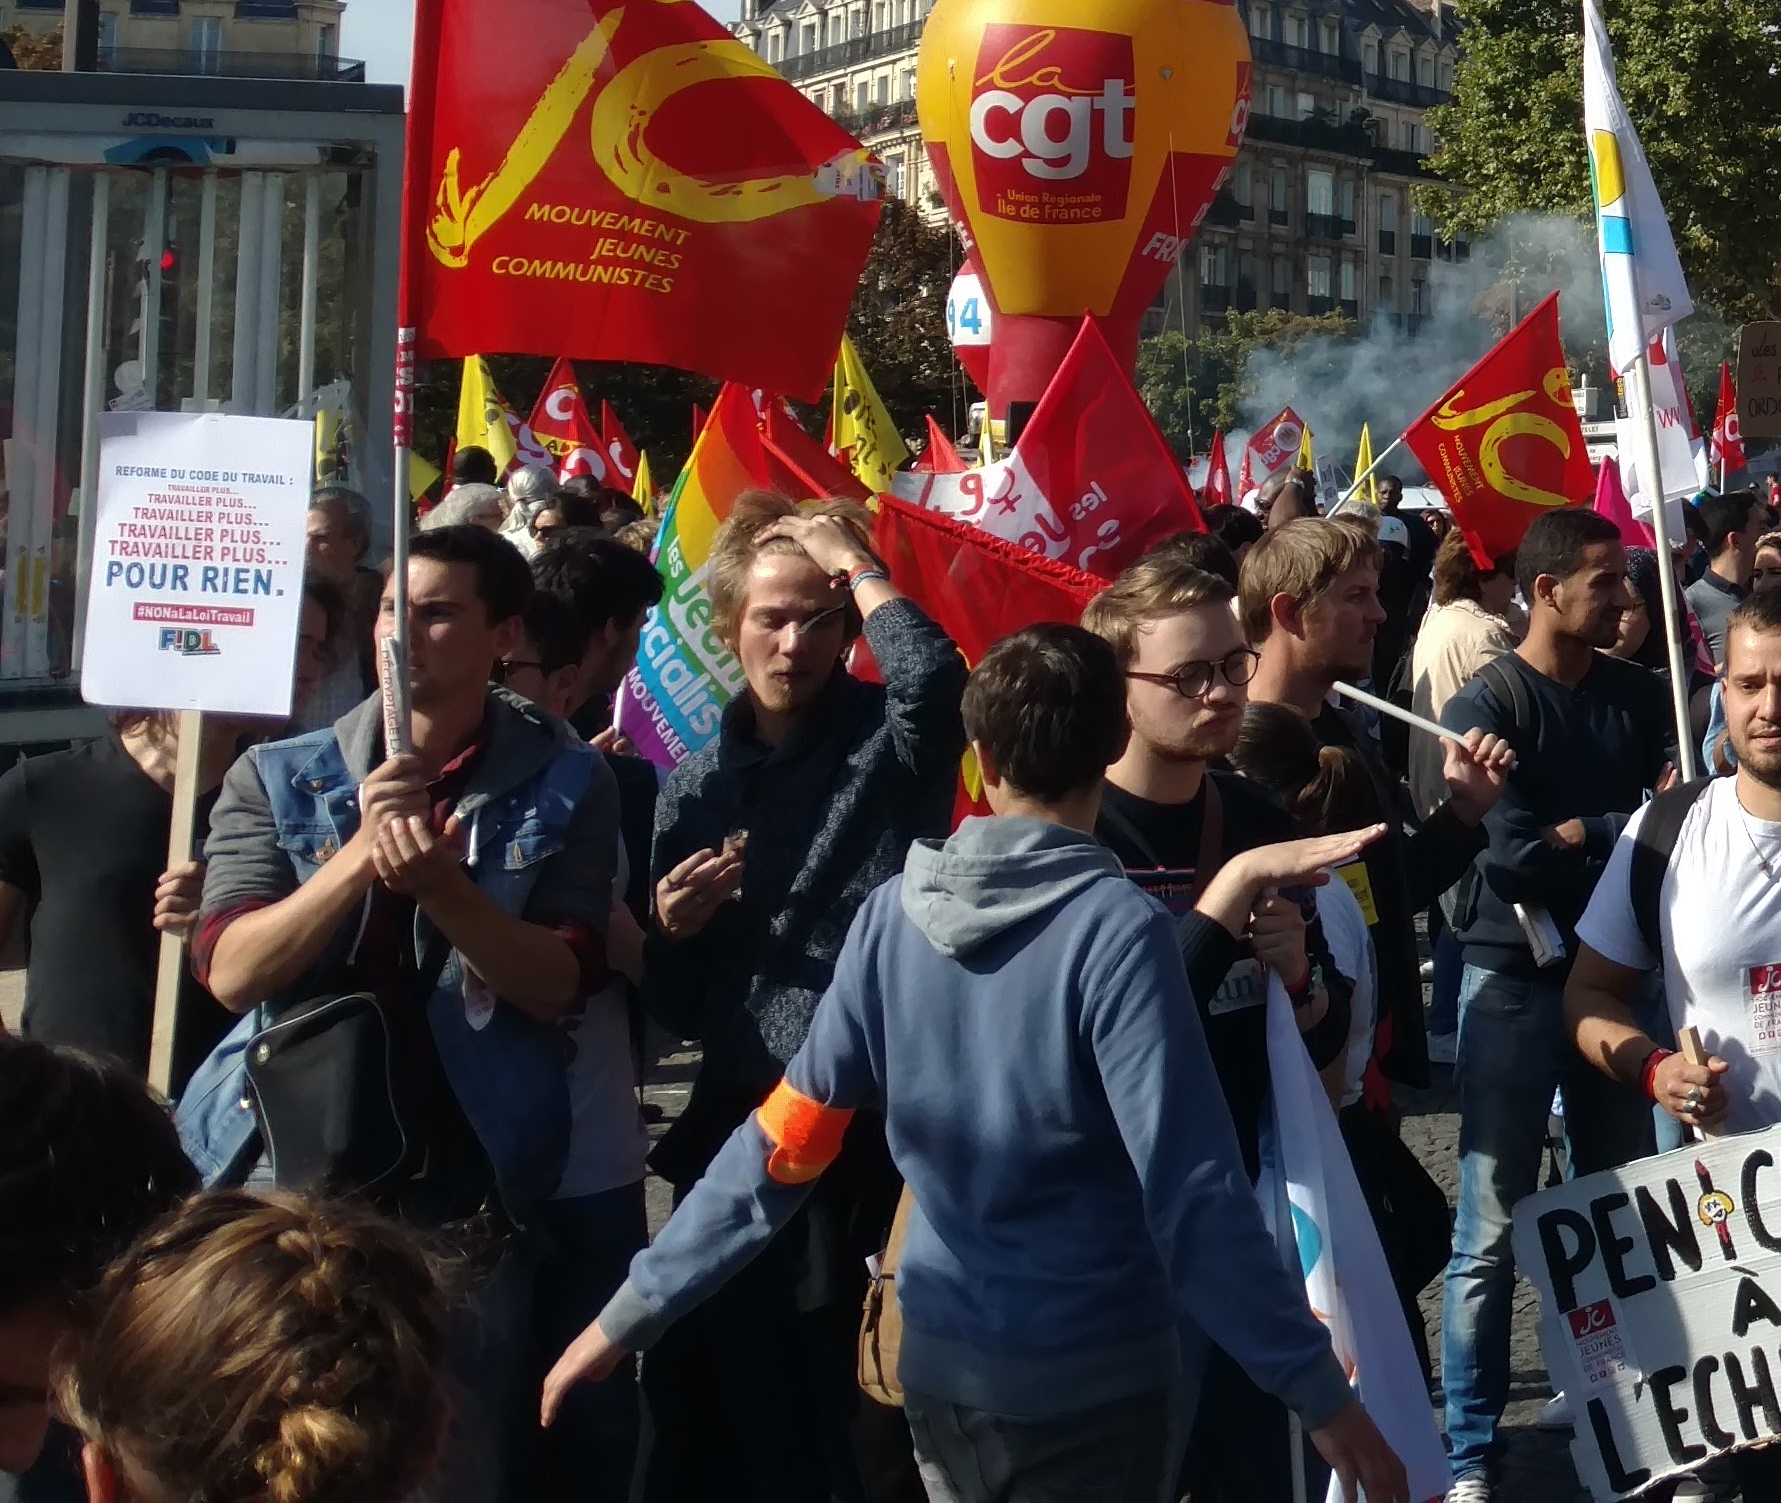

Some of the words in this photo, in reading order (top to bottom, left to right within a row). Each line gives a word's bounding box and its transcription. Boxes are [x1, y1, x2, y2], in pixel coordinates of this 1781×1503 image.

[970, 78, 1136, 180] cgt
[1019, 204, 1040, 219] de
[1044, 203, 1103, 220] France
[524, 202, 692, 247] MOUVEMENT
[589, 236, 683, 271] JEUNES
[491, 255, 675, 295] COMMUNISTES
[170, 469, 185, 480] DU
[189, 469, 220, 482] CODE
[222, 471, 238, 482] DU
[241, 473, 286, 485] TRAVAIL
[147, 493, 213, 507] TRAVAILLER
[133, 507, 214, 524] TRAVAILLER
[118, 523, 214, 543] TRAVAILLER
[108, 540, 214, 562] TRAVAILLER
[106, 560, 190, 592] POUR
[201, 565, 284, 597] RIEN.
[1580, 1335, 1622, 1358] JEUNES
